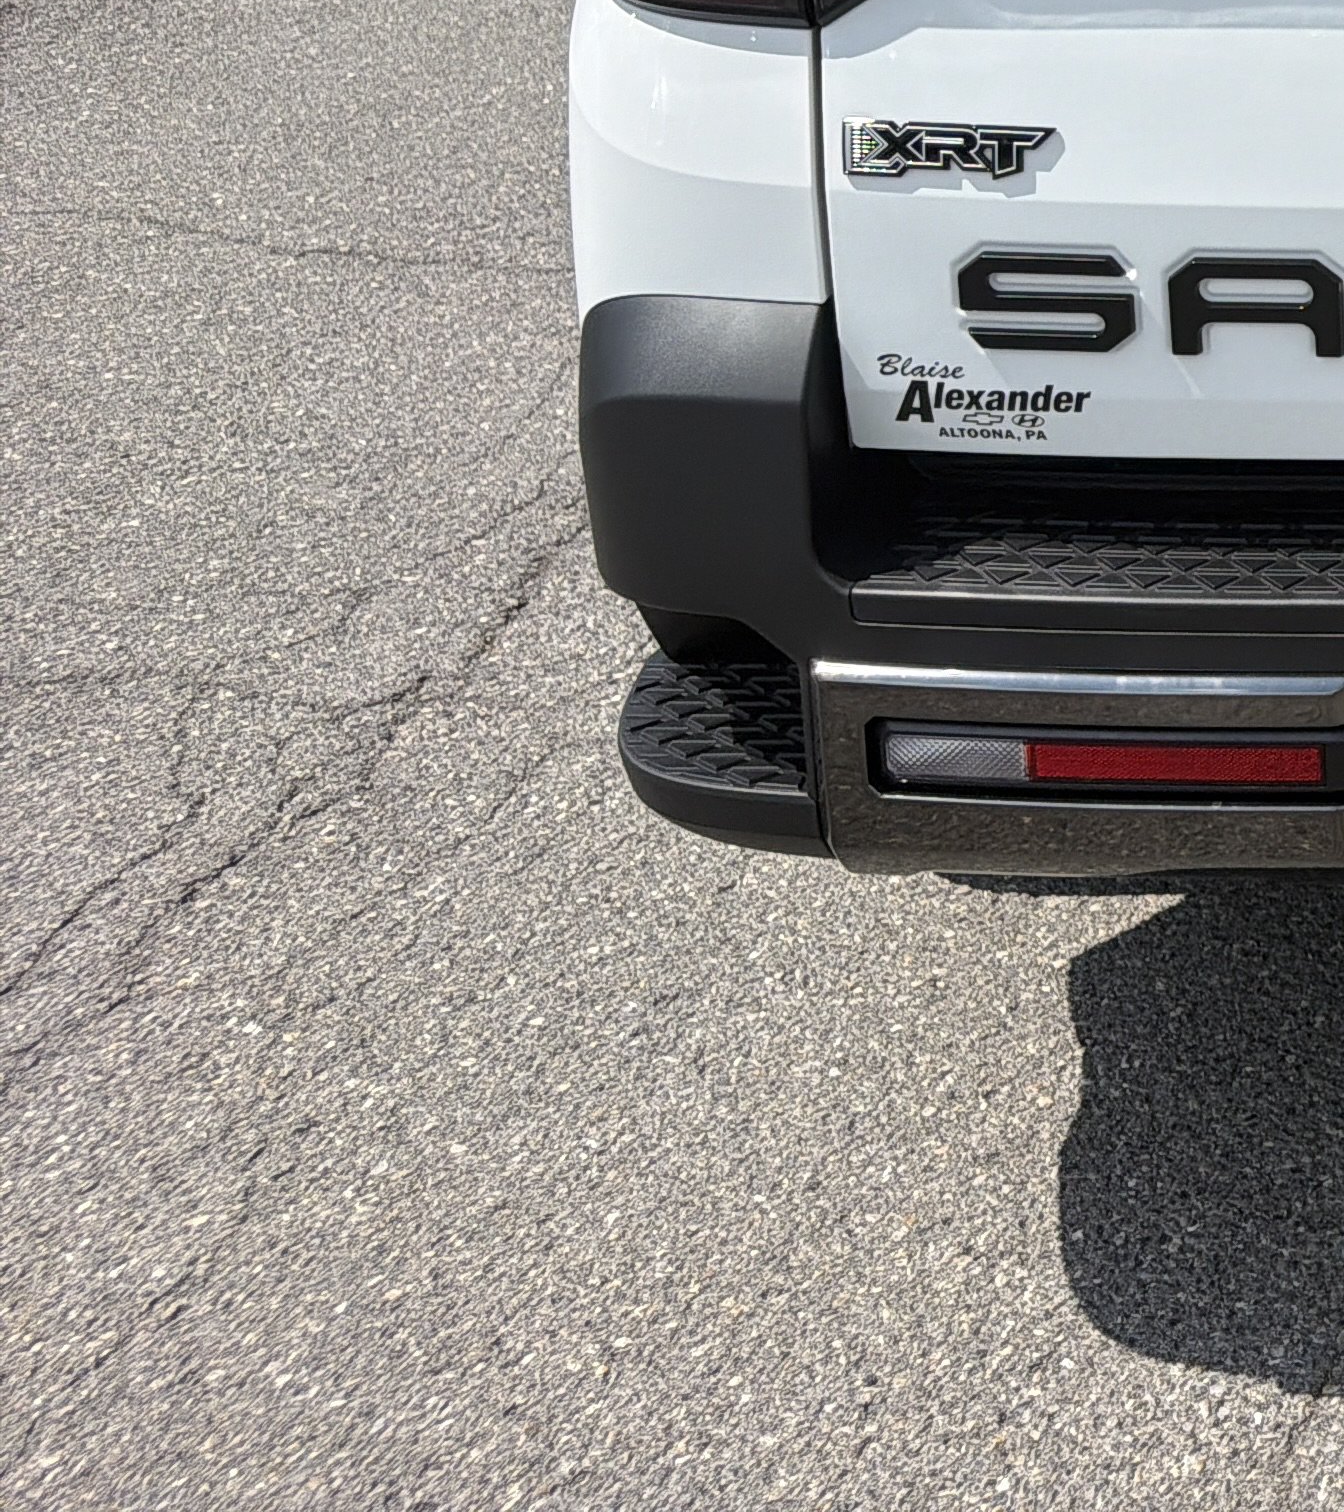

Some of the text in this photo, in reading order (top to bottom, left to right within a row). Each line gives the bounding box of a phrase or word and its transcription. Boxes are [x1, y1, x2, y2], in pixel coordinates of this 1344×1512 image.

[860, 120, 1057, 180] XRT
[876, 353, 966, 380] Blaise
[895, 379, 1092, 423] Alexander
[938, 426, 1048, 442] ALTOONA, PA
